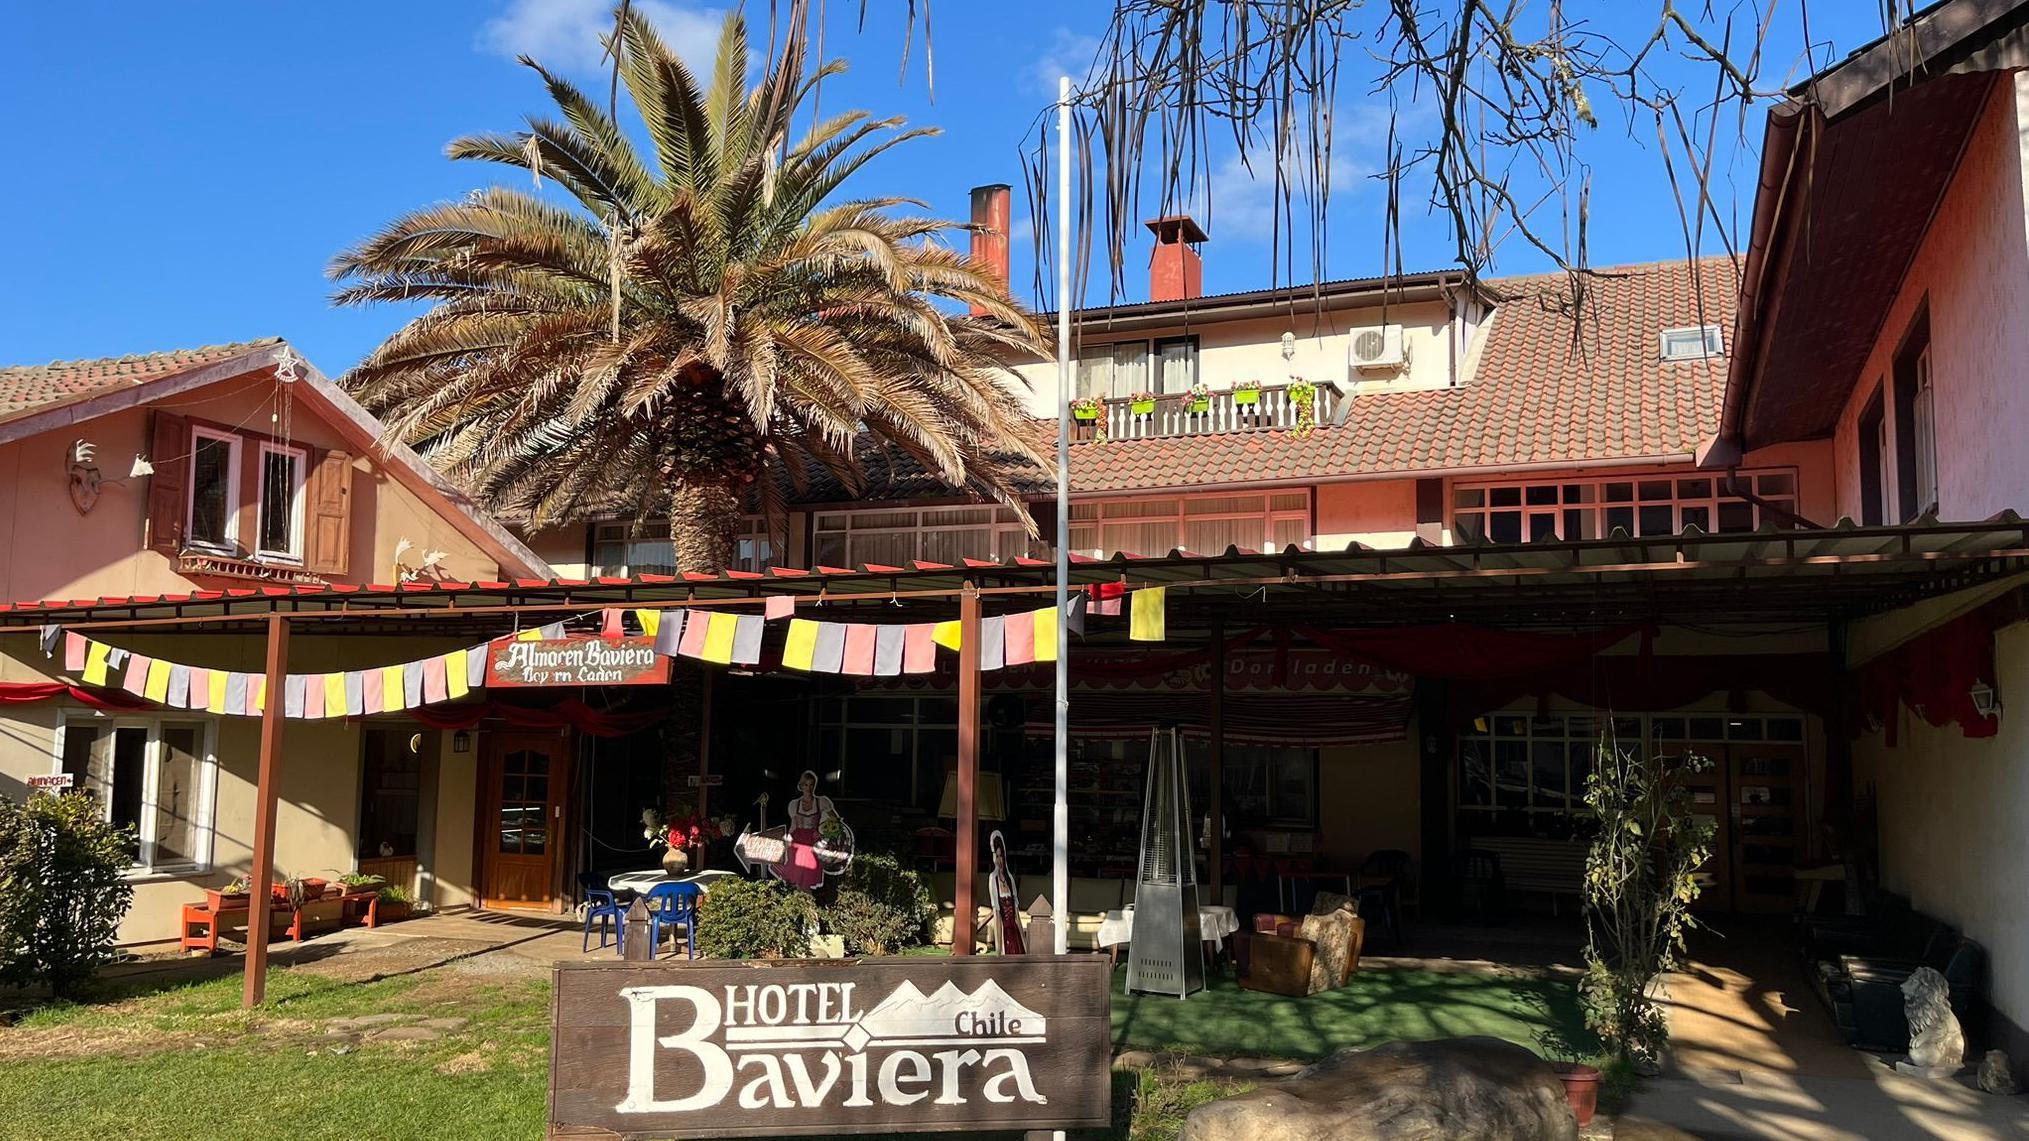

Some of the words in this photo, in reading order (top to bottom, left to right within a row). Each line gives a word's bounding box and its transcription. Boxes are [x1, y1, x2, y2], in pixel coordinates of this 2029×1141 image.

[585, 640, 655, 667] Baviera
[724, 982, 865, 1026] HOTEL
[954, 1011, 1022, 1035] Chile
[615, 985, 1048, 1114] Baviera
